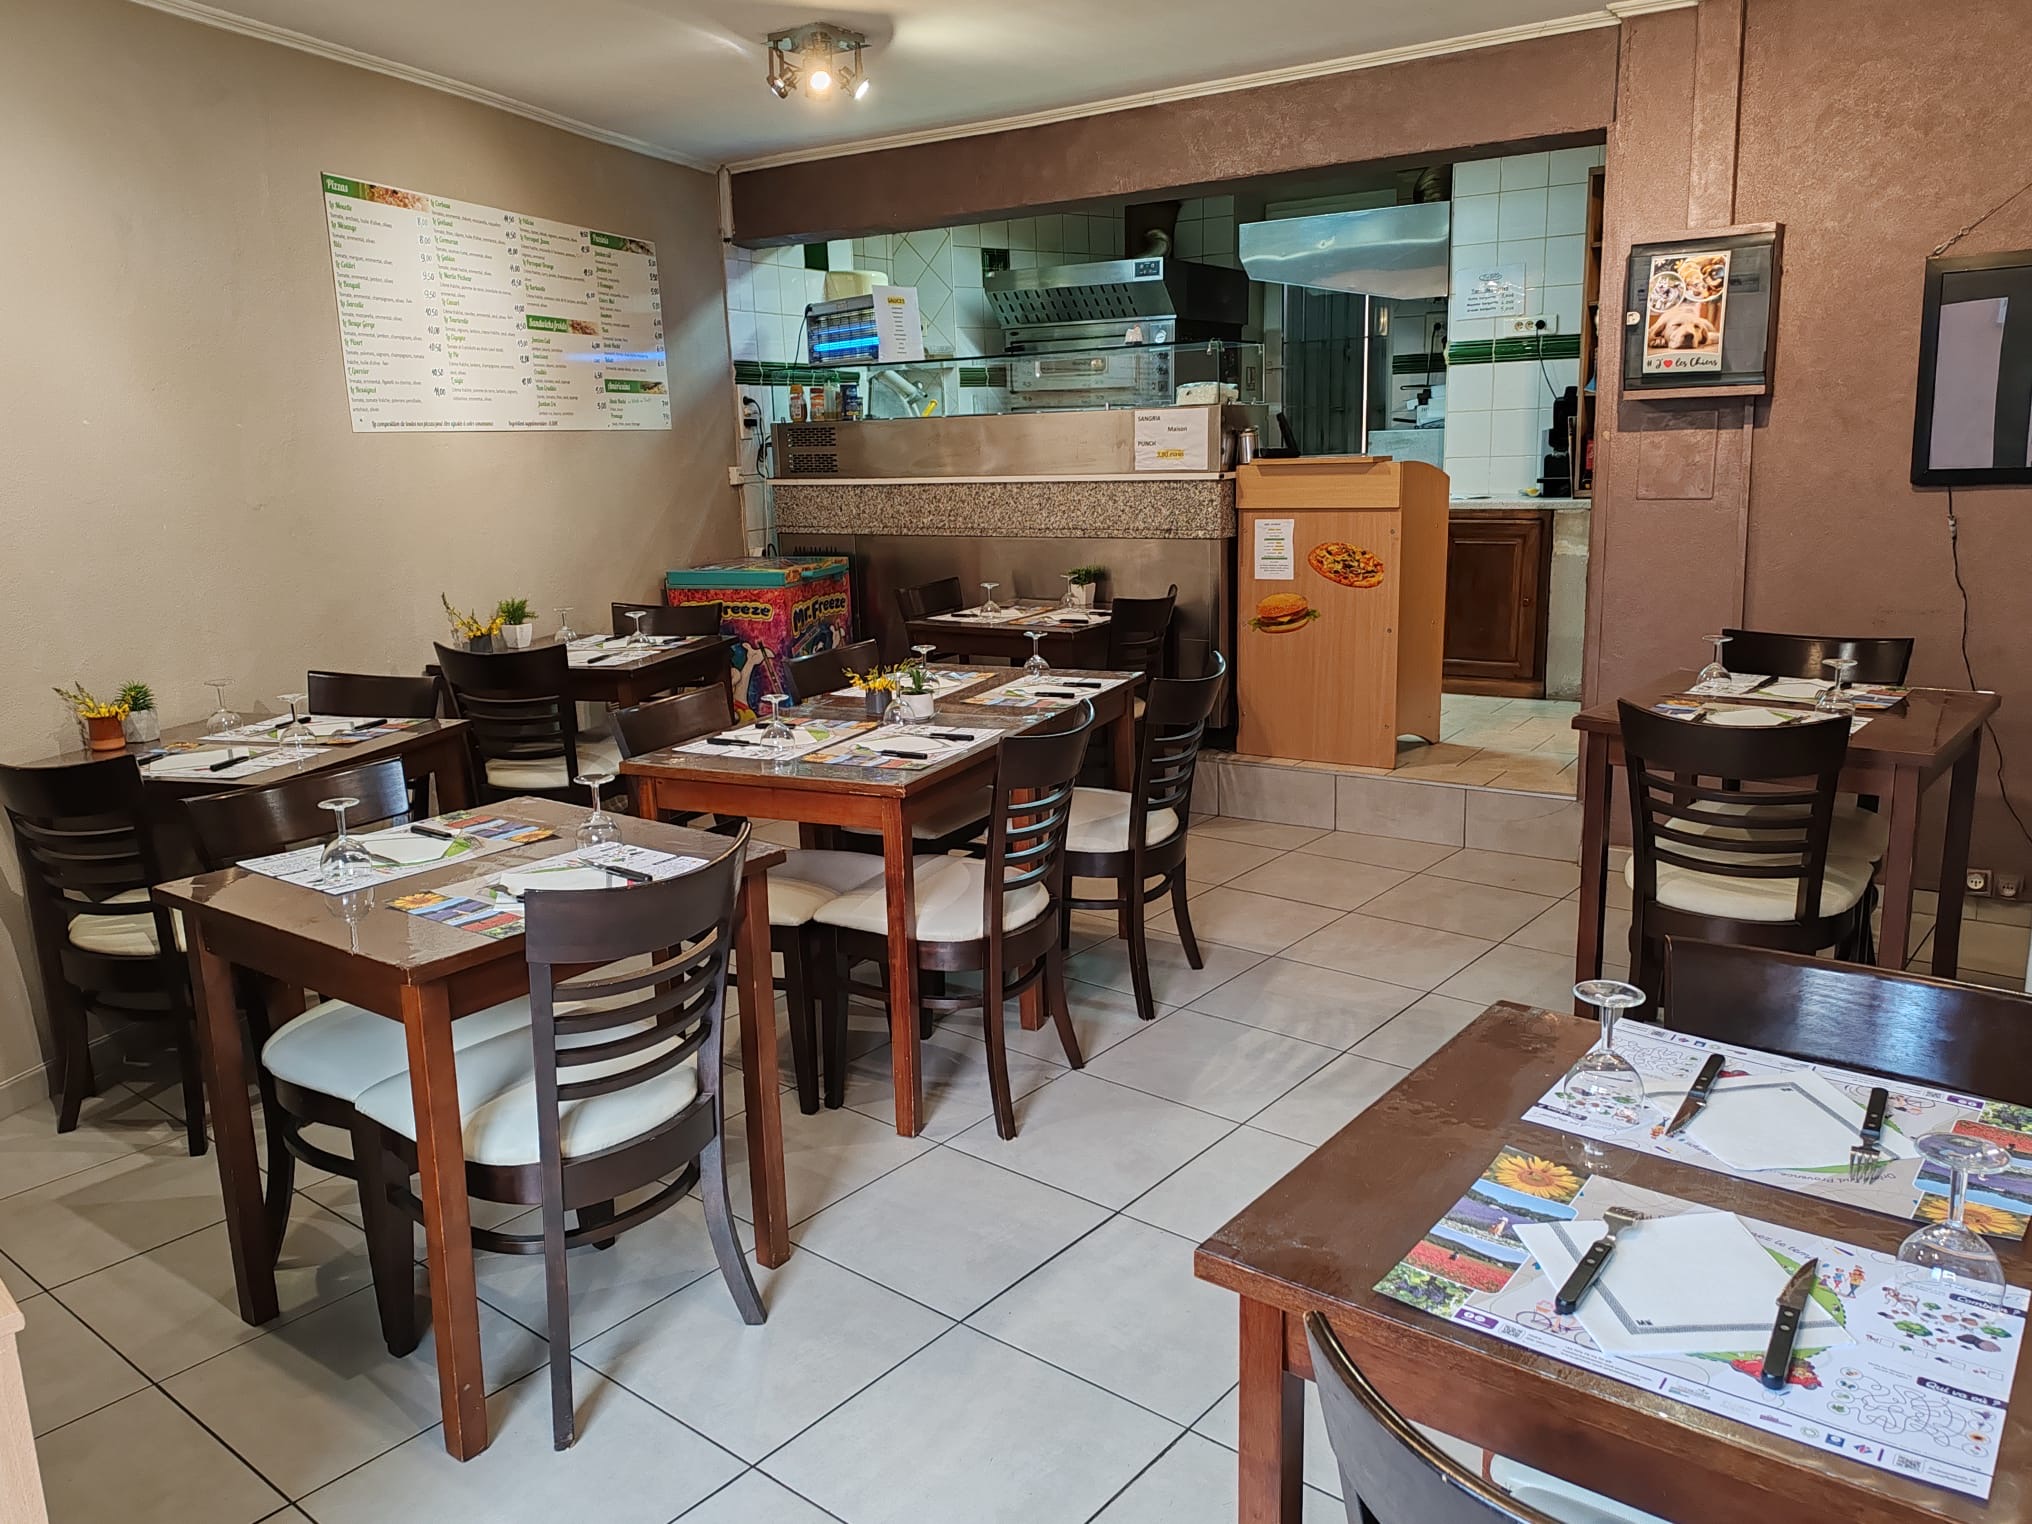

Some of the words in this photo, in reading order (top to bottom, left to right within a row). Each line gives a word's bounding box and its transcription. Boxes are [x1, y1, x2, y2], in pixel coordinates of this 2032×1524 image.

[326, 179, 348, 193] Pizzas
[1675, 356, 1688, 367] les
[1689, 357, 1718, 367] Chiens
[722, 605, 771, 617] reeze
[1957, 1296, 2009, 1315] Combin
[1925, 1381, 1950, 1394] Qui
[1951, 1389, 1968, 1400] va
[1970, 1394, 1988, 1405] où
